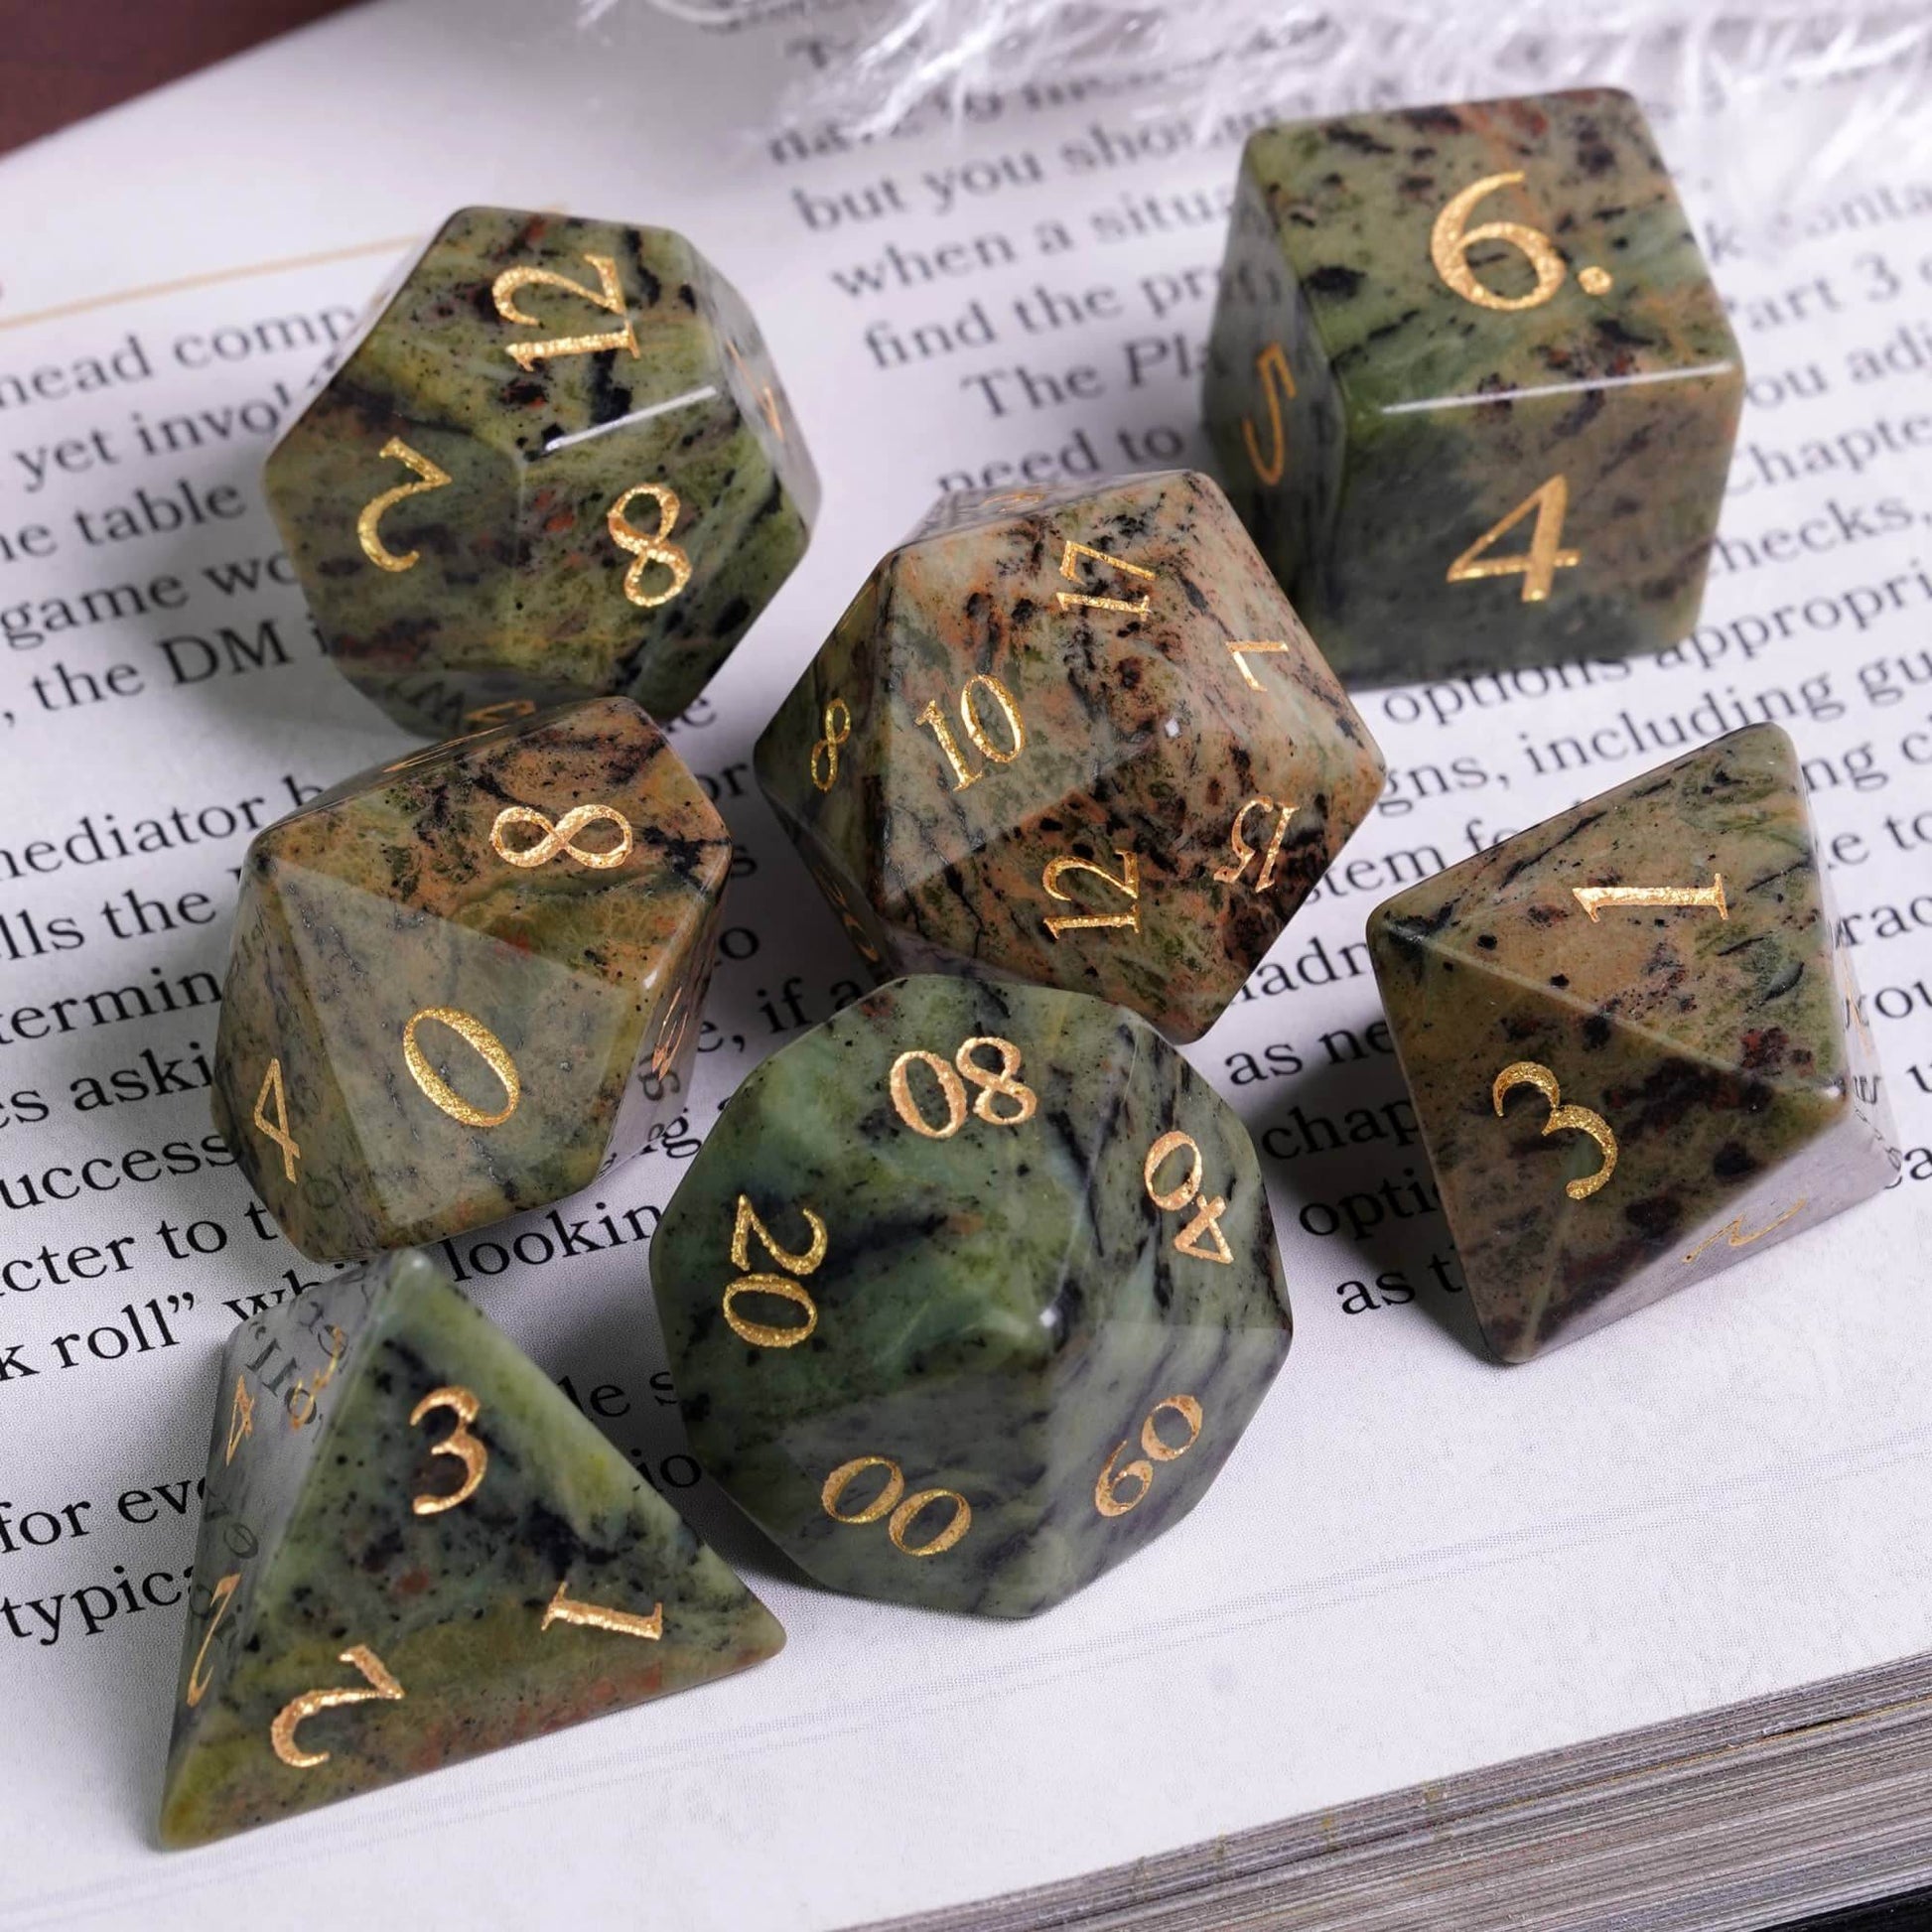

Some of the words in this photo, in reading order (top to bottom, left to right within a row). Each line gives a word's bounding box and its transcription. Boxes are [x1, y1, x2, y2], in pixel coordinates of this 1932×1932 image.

[791, 176, 905, 231] but
[921, 150, 1043, 215] you
[830, 234, 1016, 294] when
[1035, 220, 1073, 252] a
[1725, 276, 1840, 331] art
[1854, 252, 1900, 301] 3
[492, 255, 639, 371] 12
[864, 300, 998, 368] find
[1013, 284, 1125, 334] the
[1141, 265, 1220, 319] pr
[960, 362, 1106, 417] The
[15, 429, 119, 493] yet
[1117, 425, 1184, 465] to
[73, 478, 247, 546] table
[357, 436, 452, 572] 2
[608, 483, 692, 607] 8
[1447, 474, 1580, 603] 4
[0, 573, 190, 650] game
[1056, 540, 1156, 621] 17
[31, 660, 146, 712] the
[157, 618, 294, 687] DM
[810, 697, 851, 792] 8
[914, 674, 1027, 792] 10
[1519, 671, 1847, 775] including
[489, 803, 632, 870] 8
[1213, 795, 1300, 893] 15
[100, 889, 216, 940] the
[1042, 849, 1140, 939] 12
[1572, 873, 1729, 922] 1
[757, 977, 813, 1035] if
[403, 1007, 520, 1127] 0
[891, 1036, 1036, 1138] 80
[1224, 1042, 1304, 1086] as
[254, 1058, 301, 1183] 4
[1493, 1061, 1618, 1199] 3
[155, 1219, 228, 1259] to
[1145, 1131, 1233, 1264] 40
[1299, 1167, 1439, 1242] opti
[723, 1194, 827, 1347] 20
[1336, 1270, 1417, 1315] as
[410, 1386, 486, 1515] 3
[1095, 1395, 1203, 1518] 60
[822, 1455, 971, 1556] 00
[541, 1582, 662, 1641] 1
[271, 1644, 405, 1768] 2
